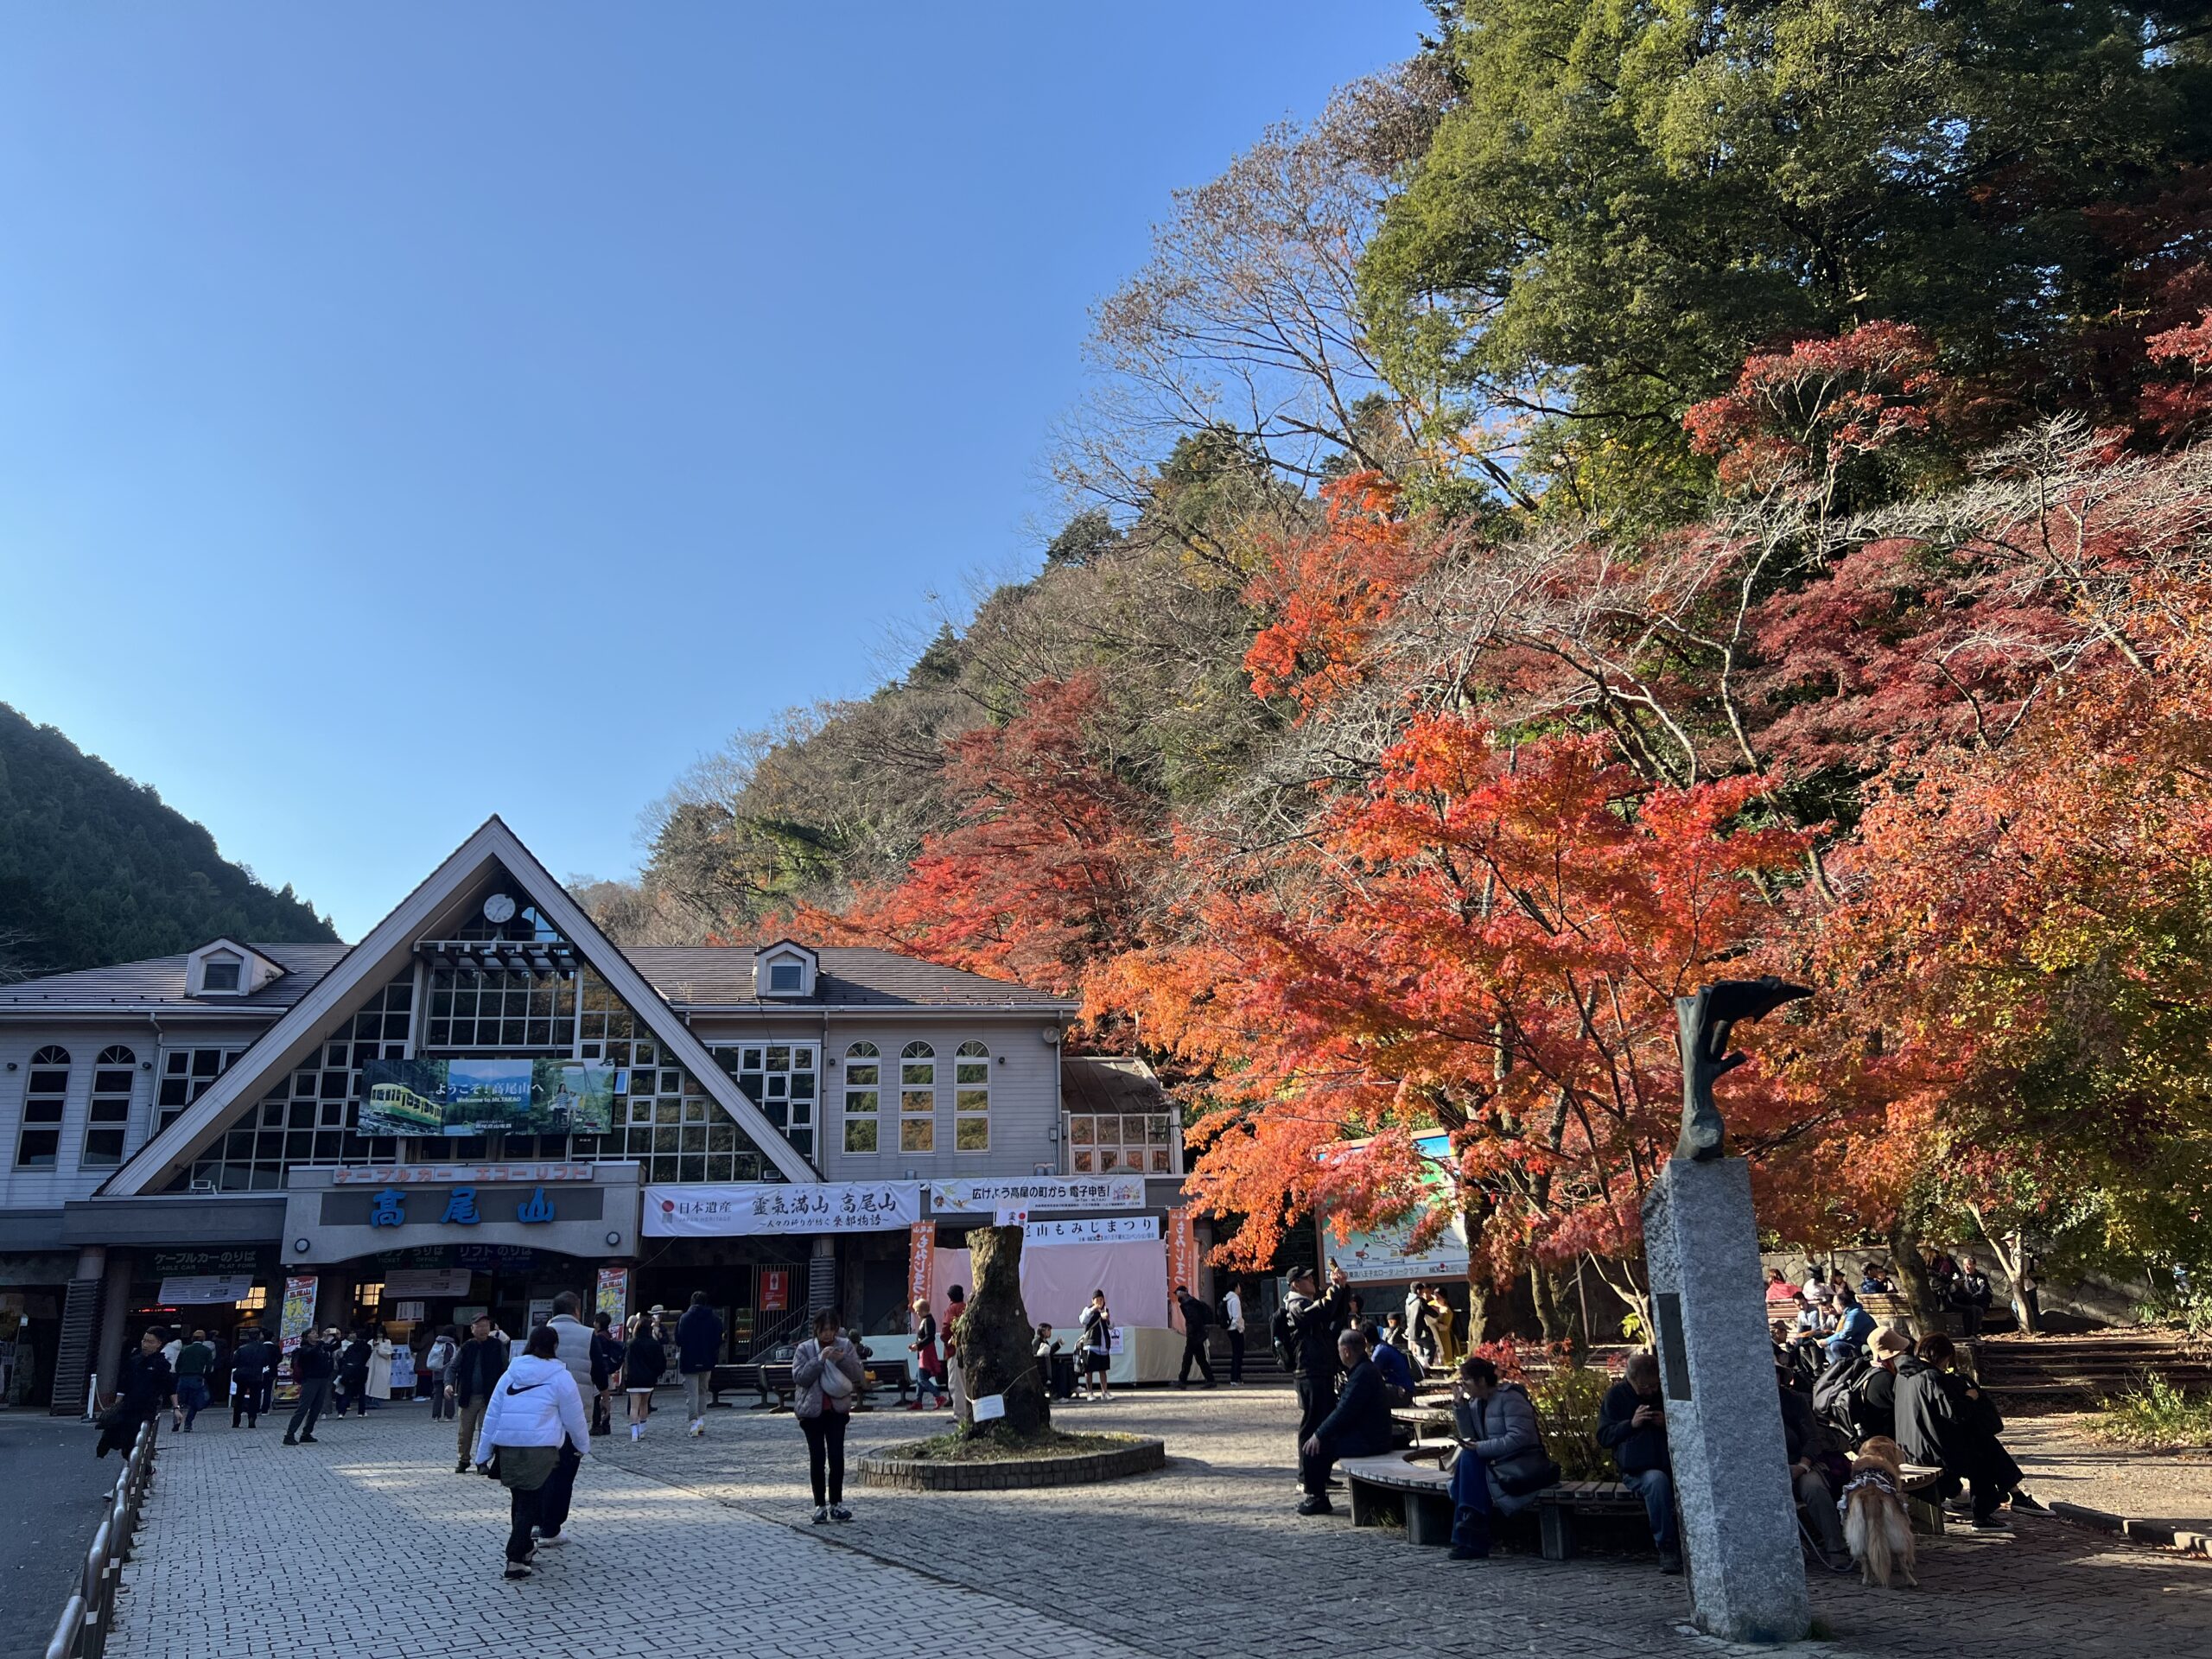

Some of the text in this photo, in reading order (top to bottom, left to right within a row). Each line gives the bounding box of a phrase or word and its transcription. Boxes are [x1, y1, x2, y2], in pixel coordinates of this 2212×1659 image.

[335, 1165, 588, 1183] ケーブルカー エコーリフト
[679, 1201, 733, 1215] 日本遺産
[840, 1192, 897, 1214] 高尾山
[154, 1250, 257, 1265] ケーブルカーのりば
